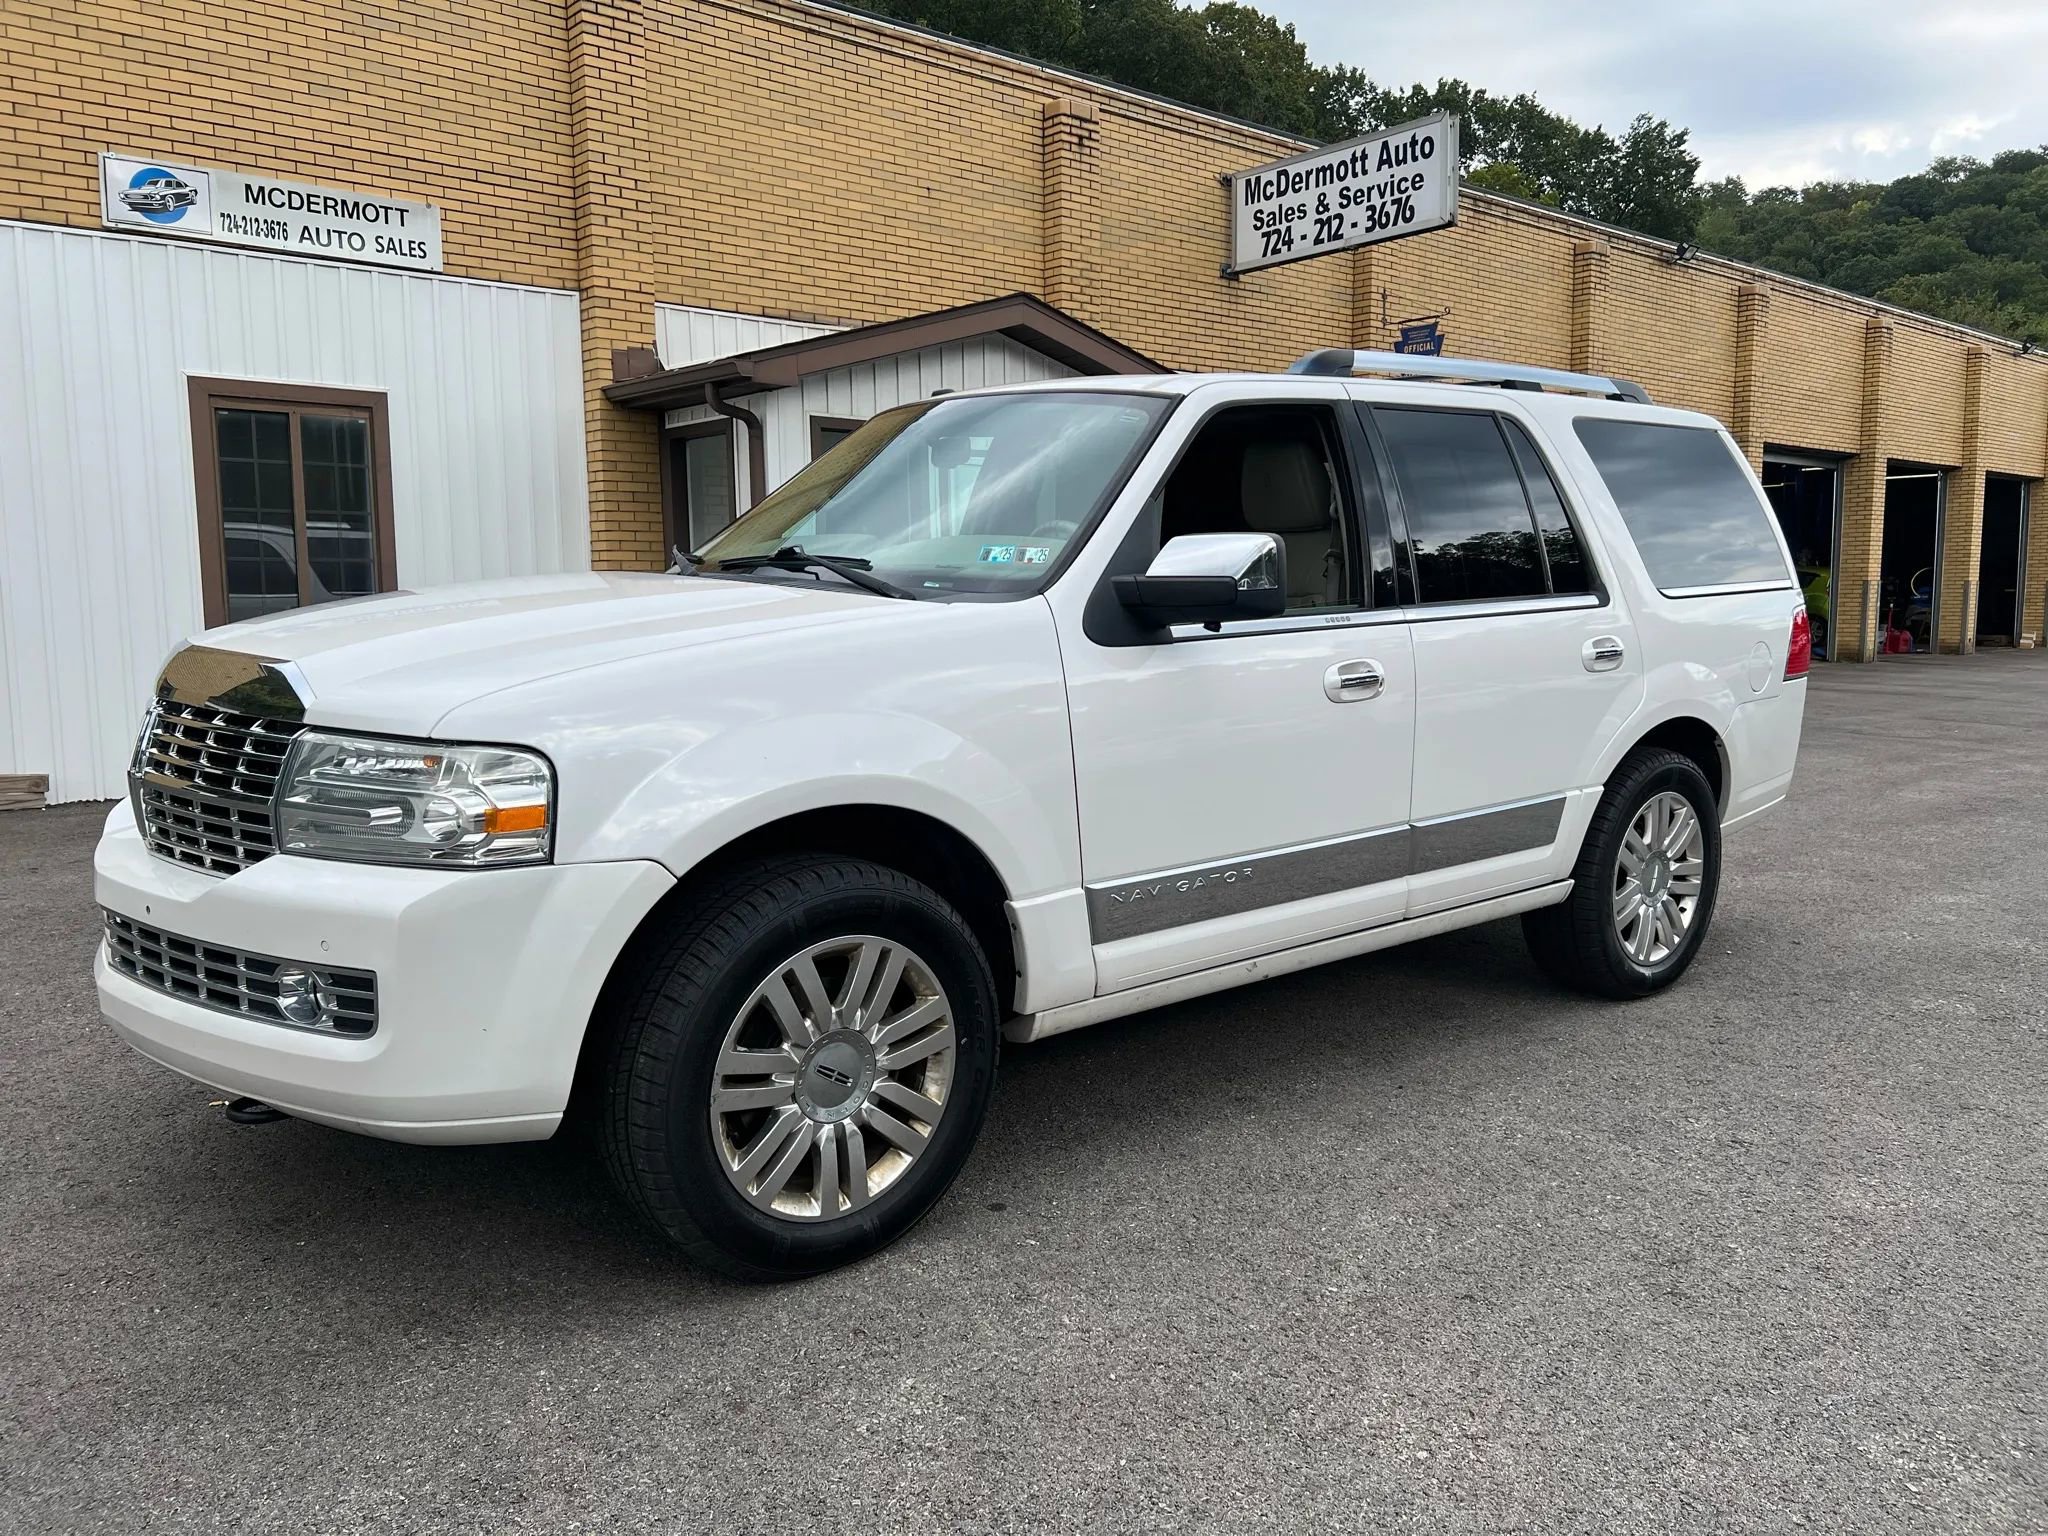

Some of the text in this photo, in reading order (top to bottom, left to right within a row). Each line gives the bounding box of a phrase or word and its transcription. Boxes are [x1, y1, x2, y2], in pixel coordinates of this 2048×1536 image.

[1244, 132, 1435, 206] McDermott Auto
[244, 183, 410, 228] MCDERMOTT
[1252, 172, 1425, 231] Sales & Service
[219, 212, 427, 259] 724-212-3676 AUTO SALES
[1261, 226, 1294, 258] 724
[1313, 212, 1344, 246] 212
[1365, 194, 1415, 234] 3676
[1403, 341, 1435, 354] OFFICIAL
[1110, 867, 1254, 903] NAVGATOR
